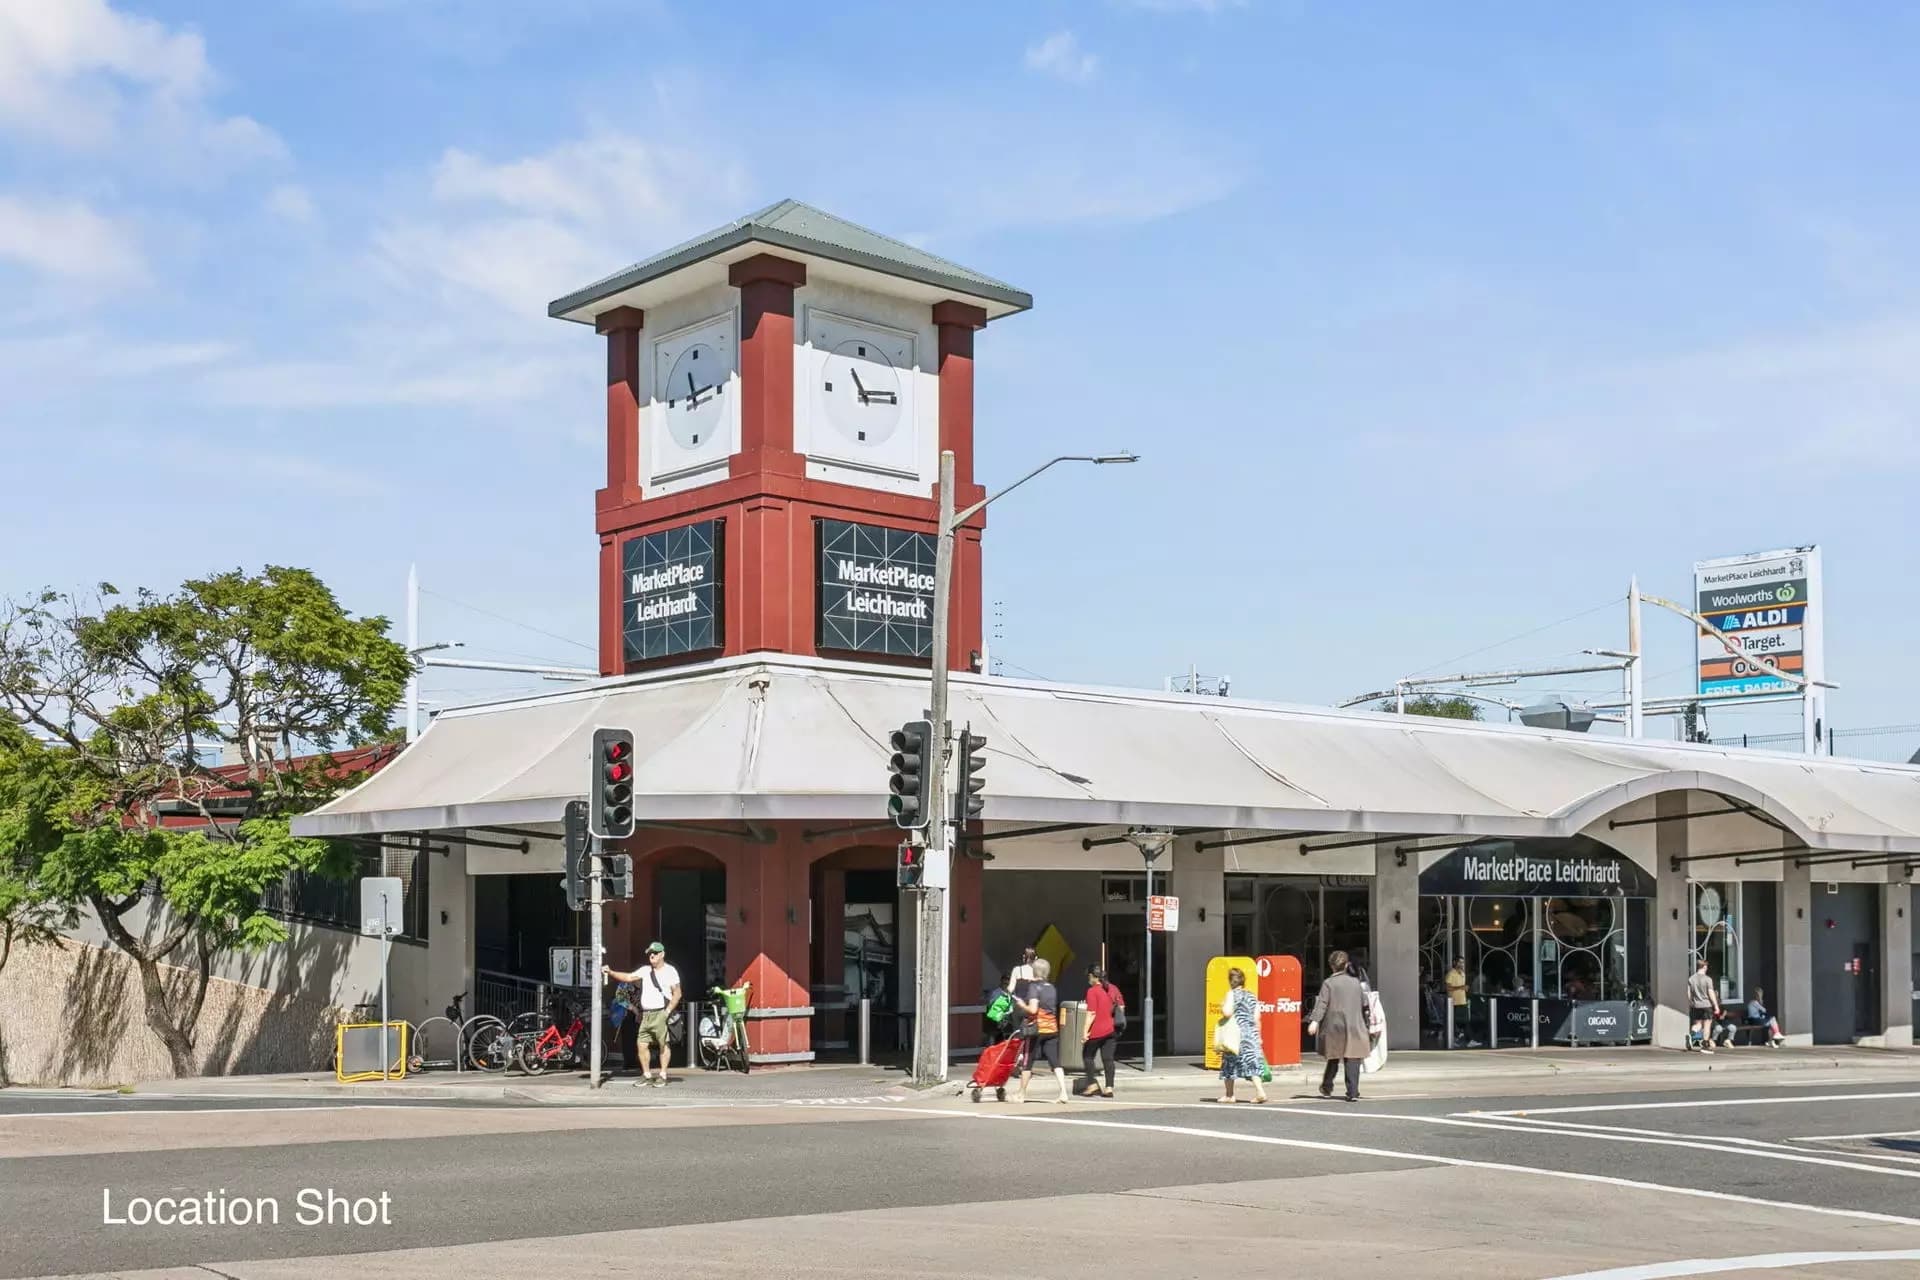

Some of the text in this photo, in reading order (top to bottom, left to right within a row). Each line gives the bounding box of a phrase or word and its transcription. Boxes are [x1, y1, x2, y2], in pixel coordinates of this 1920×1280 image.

[632, 563, 704, 594] MarketPlace
[838, 560, 935, 591] MarketPlace
[1703, 567, 1786, 584] MarketPlace Leichhardt
[637, 591, 698, 622] Leichhardt
[847, 590, 927, 619] Leichhardt
[1711, 589, 1773, 607] Woolworths
[1742, 608, 1787, 629] ALDI
[1463, 856, 1621, 884] MarketPlace Leichhardt
[1258, 1001, 1302, 1013] OST POST
[1506, 1012, 1551, 1024] ORGACA
[1588, 1016, 1617, 1026] ORGANICA
